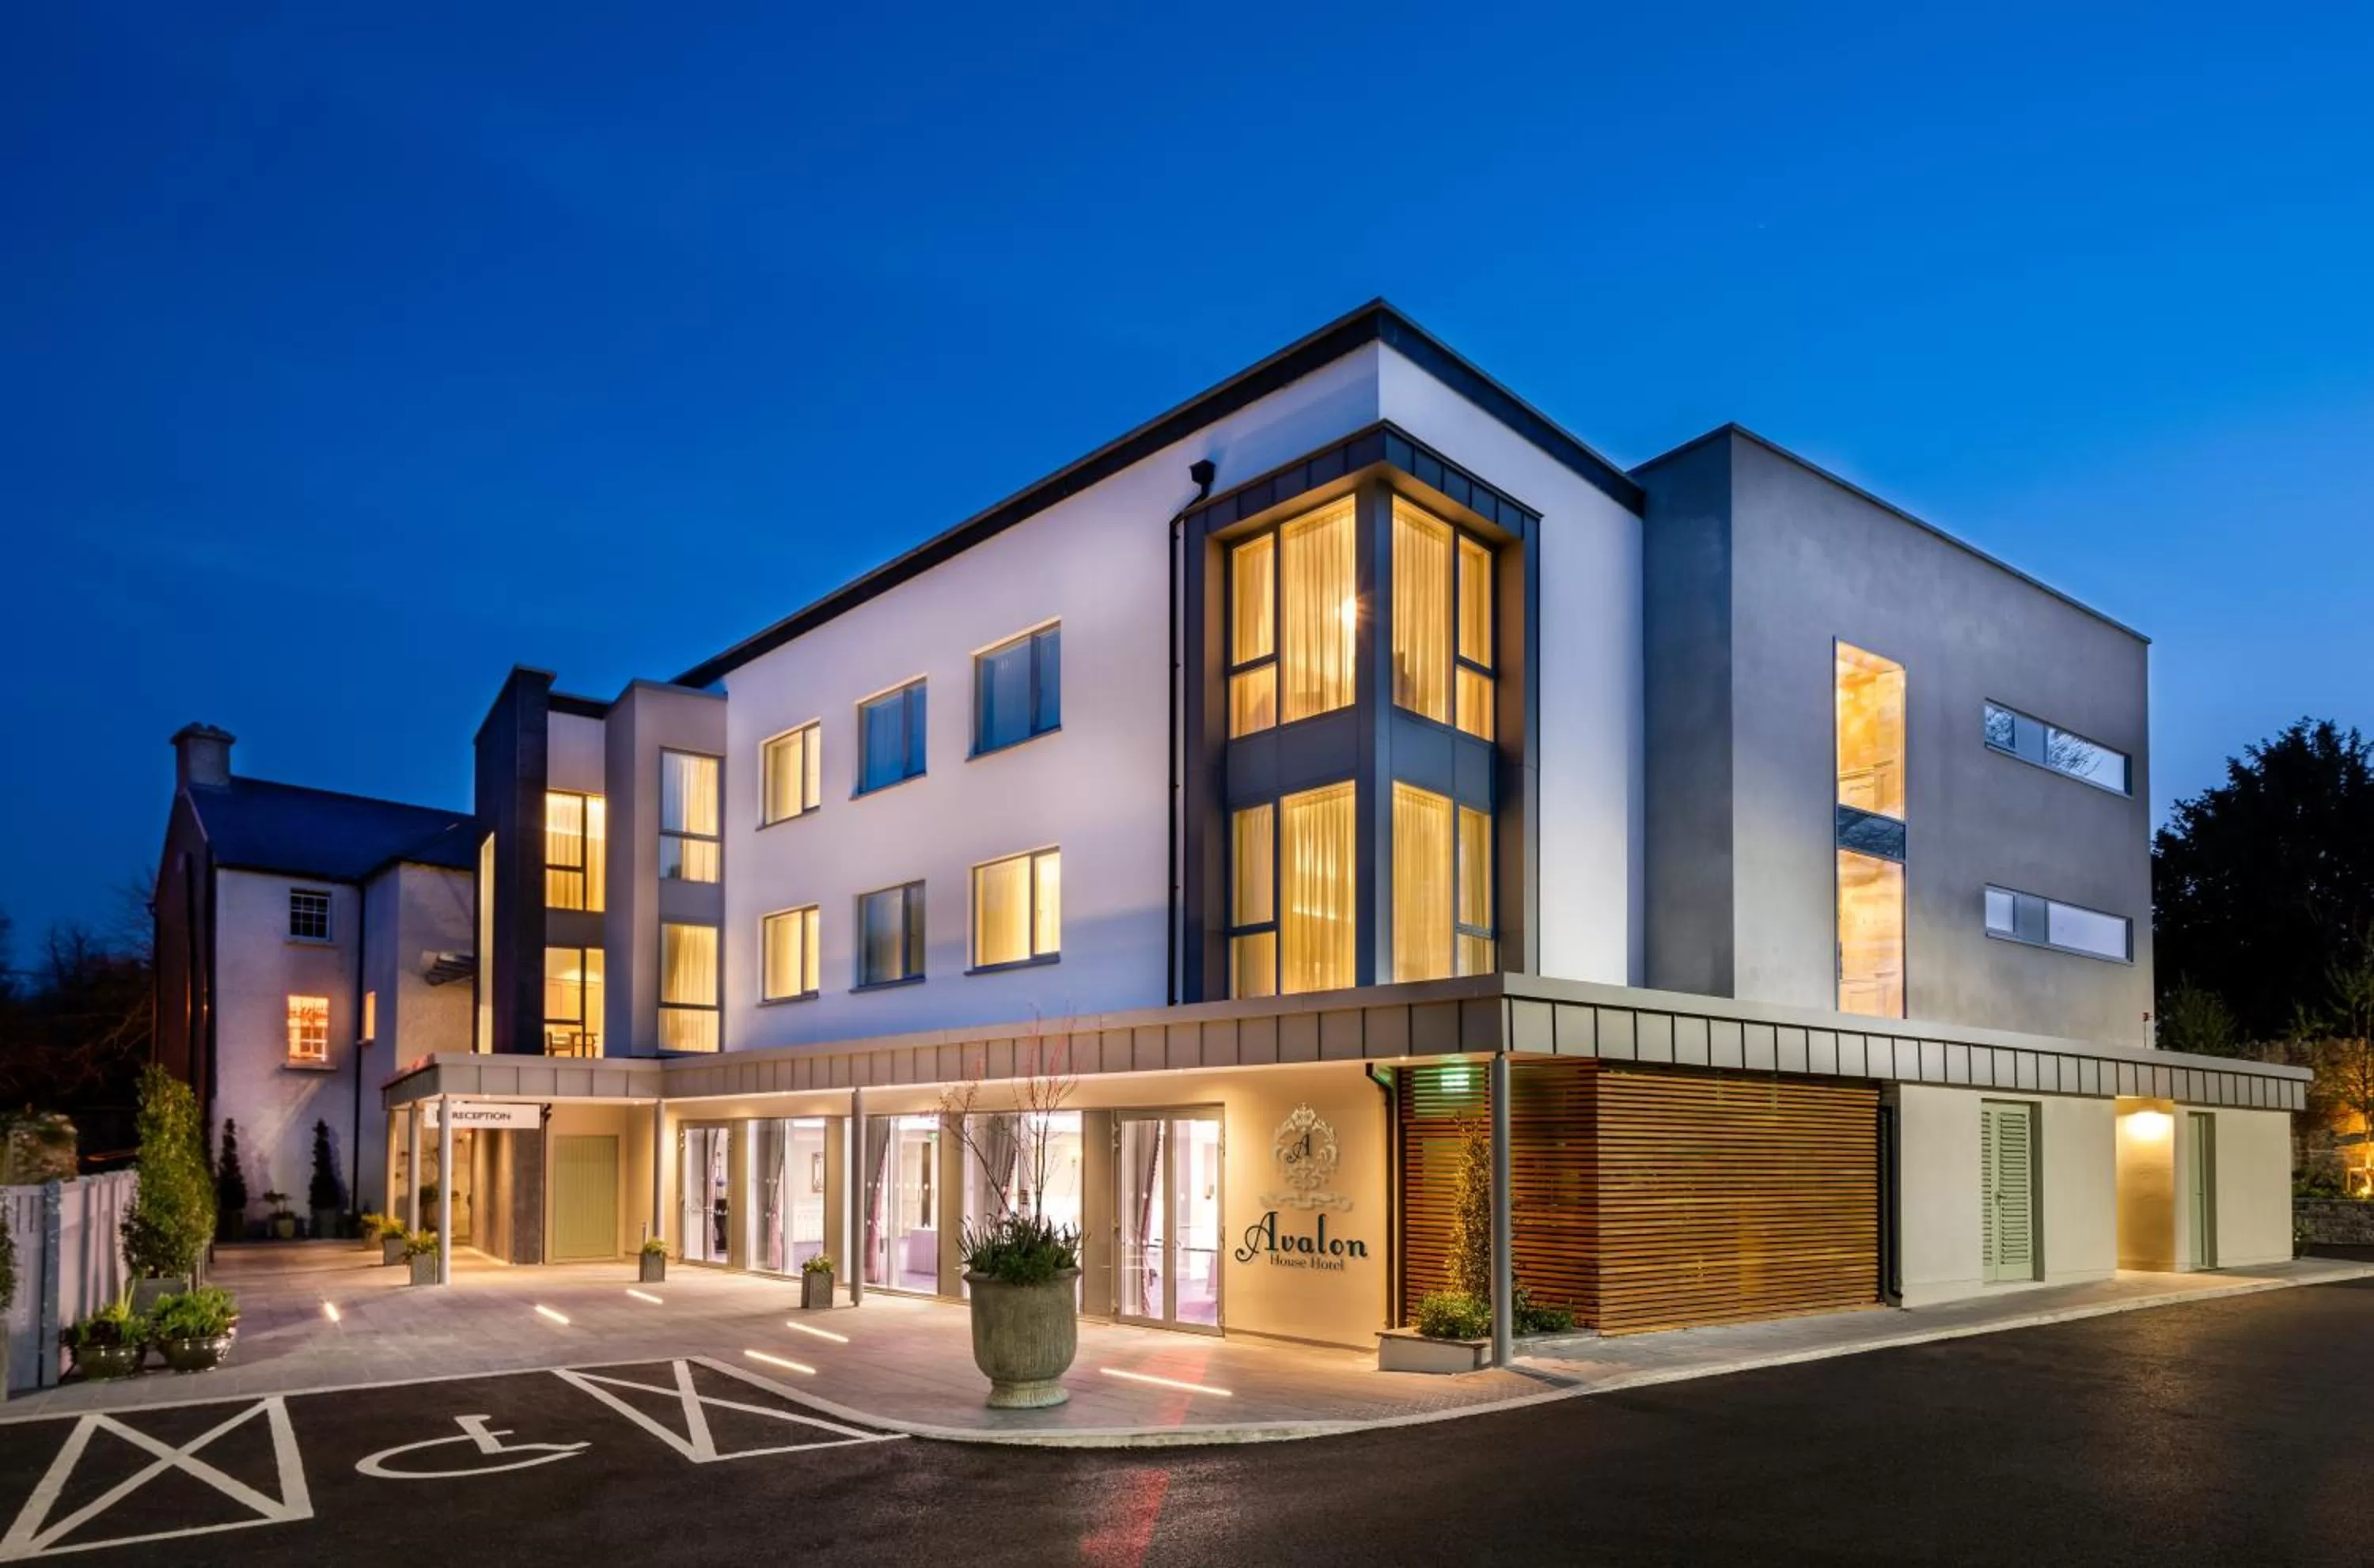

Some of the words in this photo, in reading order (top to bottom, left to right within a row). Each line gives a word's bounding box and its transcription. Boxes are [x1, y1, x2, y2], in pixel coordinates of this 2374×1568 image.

[452, 1110, 512, 1121] RECEPTION
[1286, 1134, 1310, 1164] A
[1234, 1211, 1368, 1262] Avalon
[1270, 1254, 1306, 1269] House
[1310, 1257, 1344, 1271] Hotel
